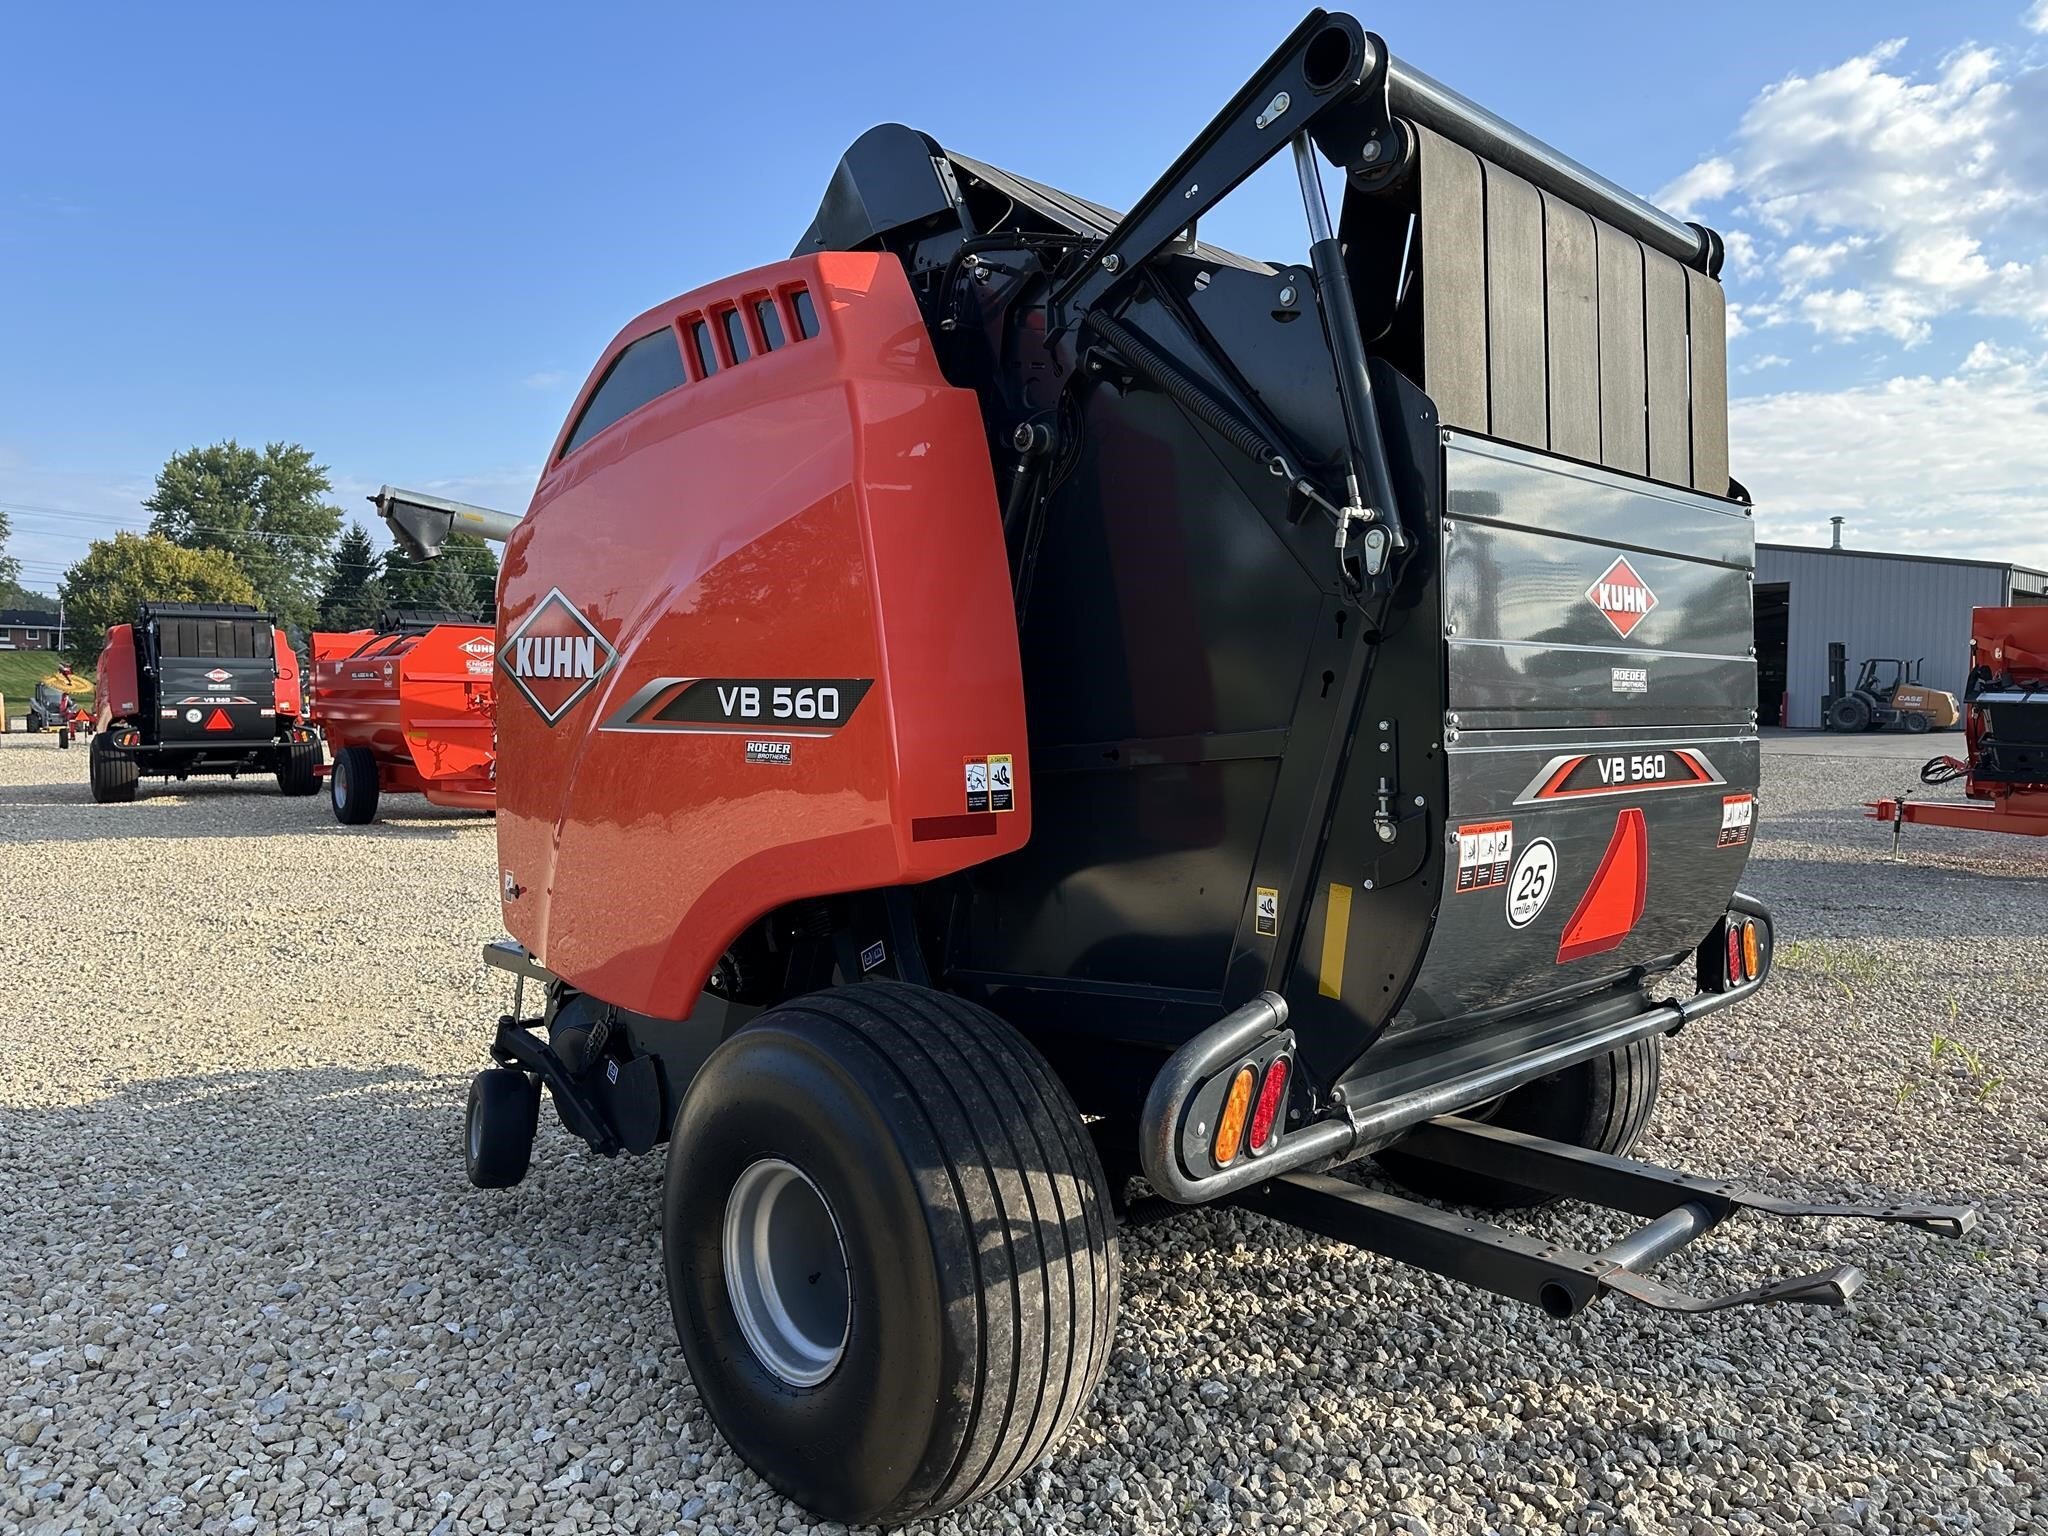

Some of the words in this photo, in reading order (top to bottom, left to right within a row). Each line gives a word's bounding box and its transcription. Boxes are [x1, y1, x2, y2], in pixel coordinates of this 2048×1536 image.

[1599, 583, 1647, 613] KUHN
[516, 636, 595, 679] KUHN
[1613, 670, 1647, 681] ROEDER
[717, 686, 760, 717] VB
[773, 687, 839, 720] 560
[747, 742, 791, 754] ROEDER
[1597, 757, 1625, 784] VB
[1631, 754, 1666, 780] 560
[1516, 864, 1548, 902] 25
[1512, 900, 1539, 917] mile/h
